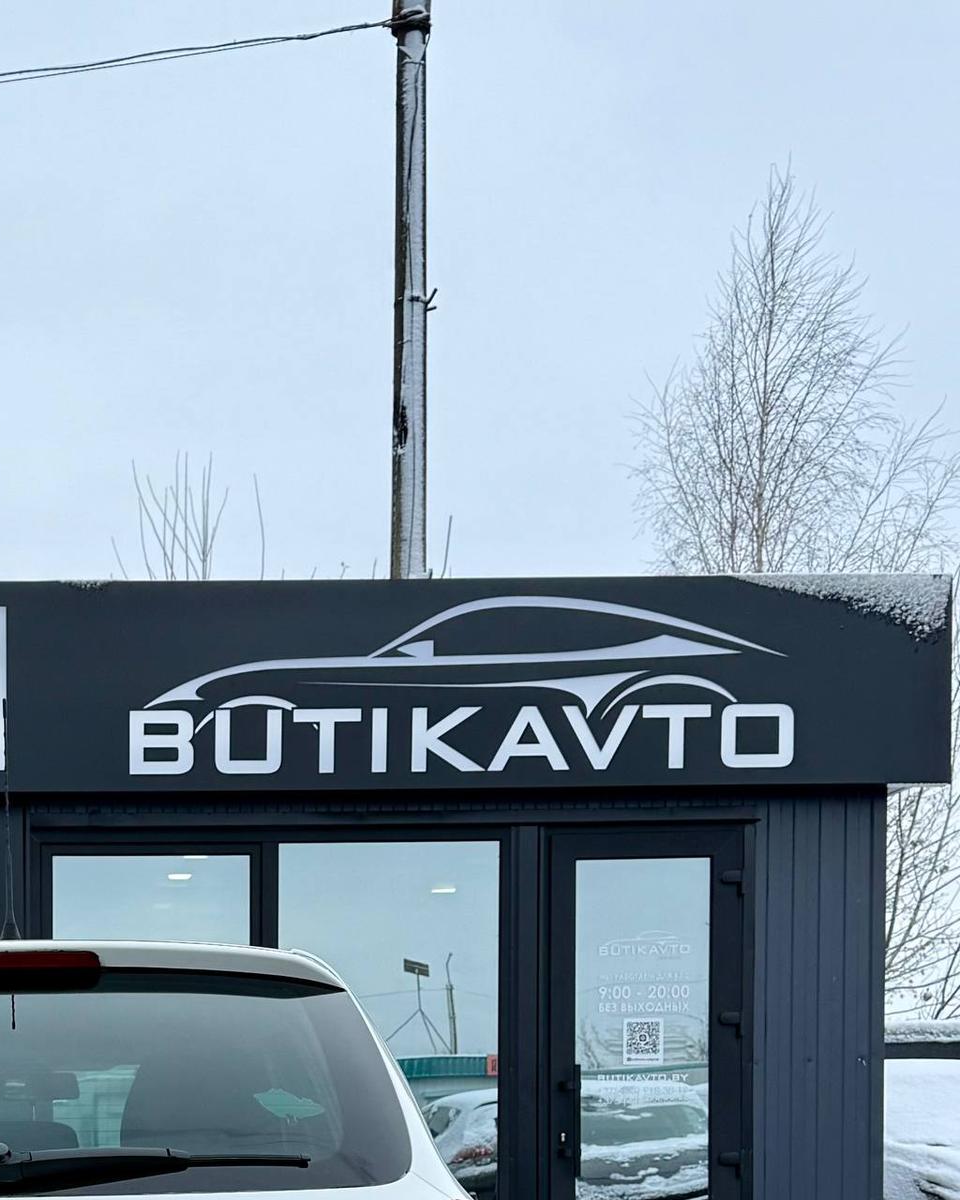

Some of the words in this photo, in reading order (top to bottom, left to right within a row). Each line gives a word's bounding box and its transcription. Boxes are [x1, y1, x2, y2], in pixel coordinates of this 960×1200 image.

[128, 703, 795, 775] BUTIKAVTO
[599, 944, 690, 956] BUTIKAVTO
[598, 986, 631, 999] 9:00
[648, 985, 690, 999] 20:00
[599, 1003, 617, 1013] БЕЗ
[621, 1002, 689, 1013] ВЫХОДНЫХ
